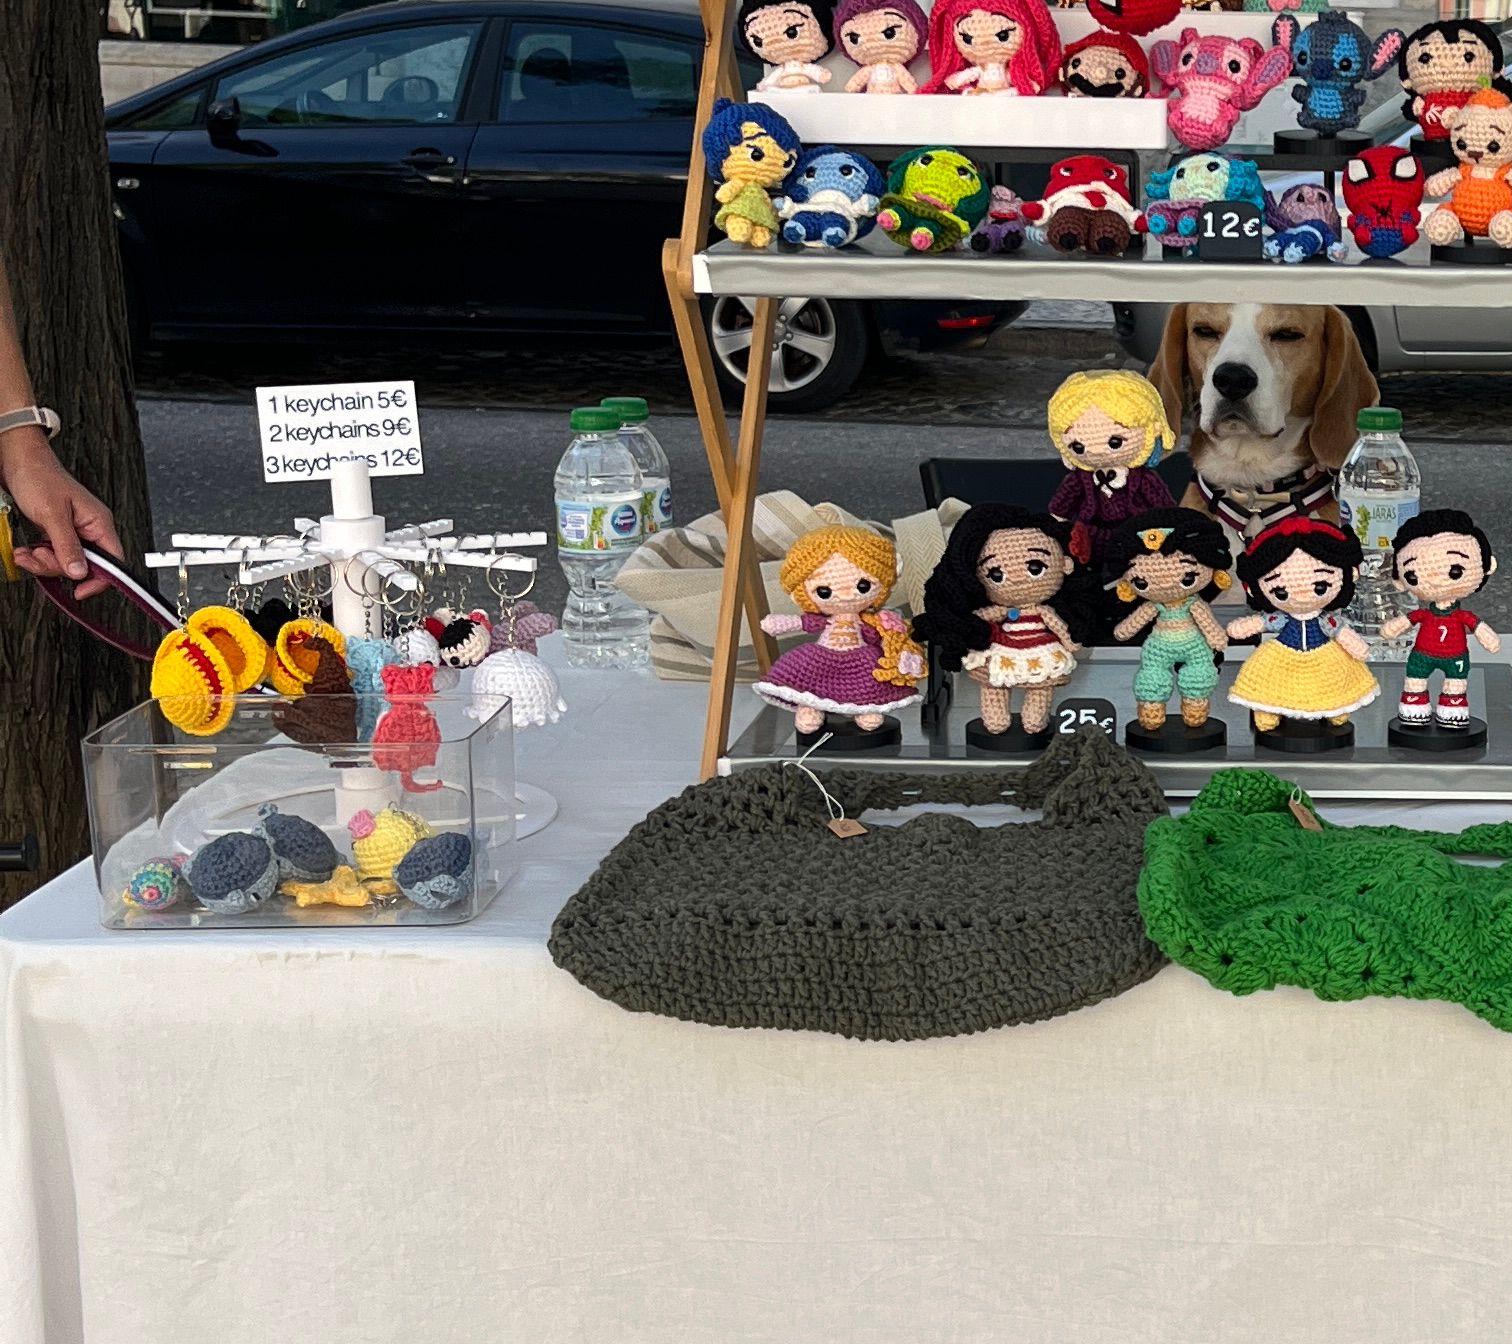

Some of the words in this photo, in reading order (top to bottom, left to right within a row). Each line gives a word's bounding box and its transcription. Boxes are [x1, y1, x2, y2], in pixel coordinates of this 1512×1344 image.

[1203, 211, 1260, 238] 12€
[268, 396, 278, 414] 1
[284, 391, 374, 417] keychain
[377, 389, 407, 409] 5€
[269, 424, 283, 443] 2
[284, 420, 380, 445] keychains
[382, 417, 412, 436] 9€
[266, 455, 280, 474] 3
[381, 447, 421, 467] 12€
[1438, 625, 1448, 643] 7
[1455, 660, 1464, 673] 7
